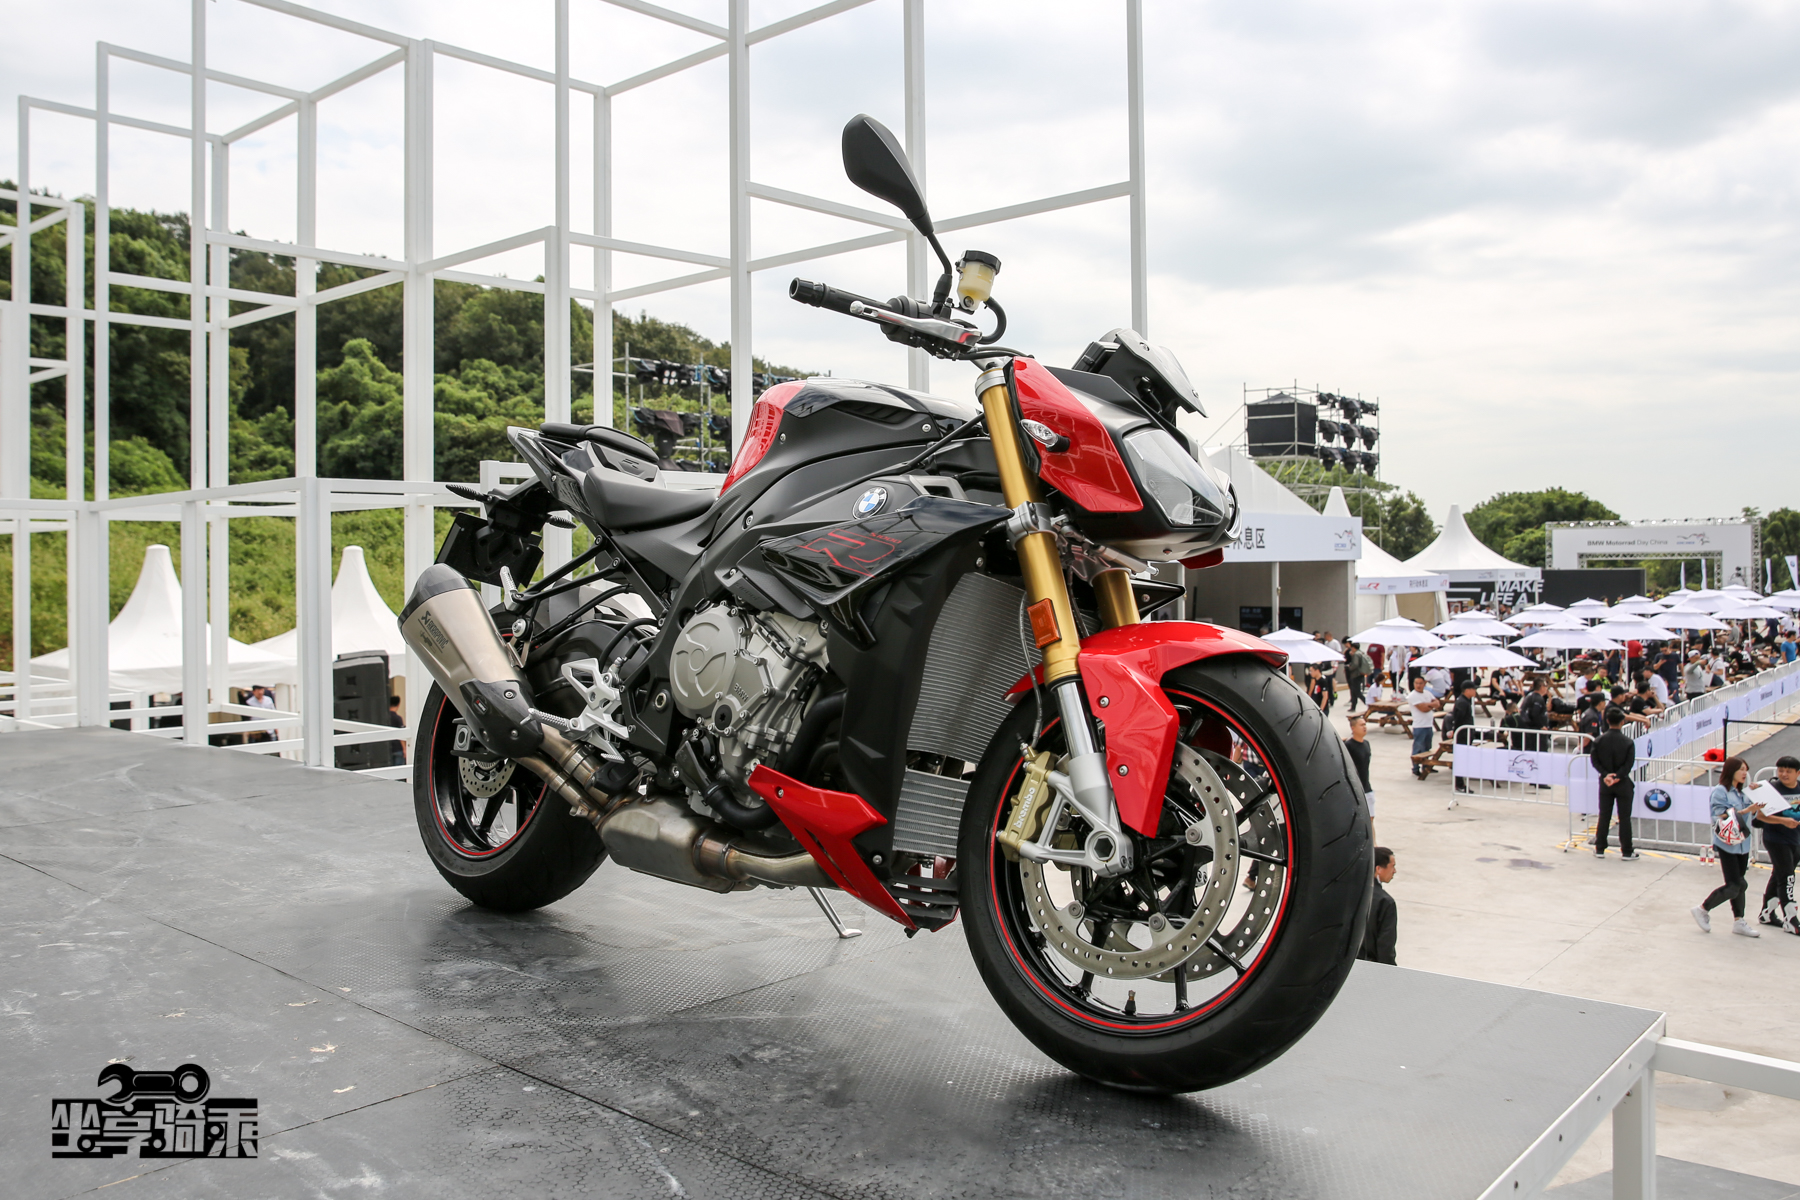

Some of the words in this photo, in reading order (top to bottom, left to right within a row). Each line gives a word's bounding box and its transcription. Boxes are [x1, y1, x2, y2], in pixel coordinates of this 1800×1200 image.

[1497, 579, 1545, 593] MAKE
[1515, 592, 1529, 605] A
[1013, 787, 1036, 829] brembo
